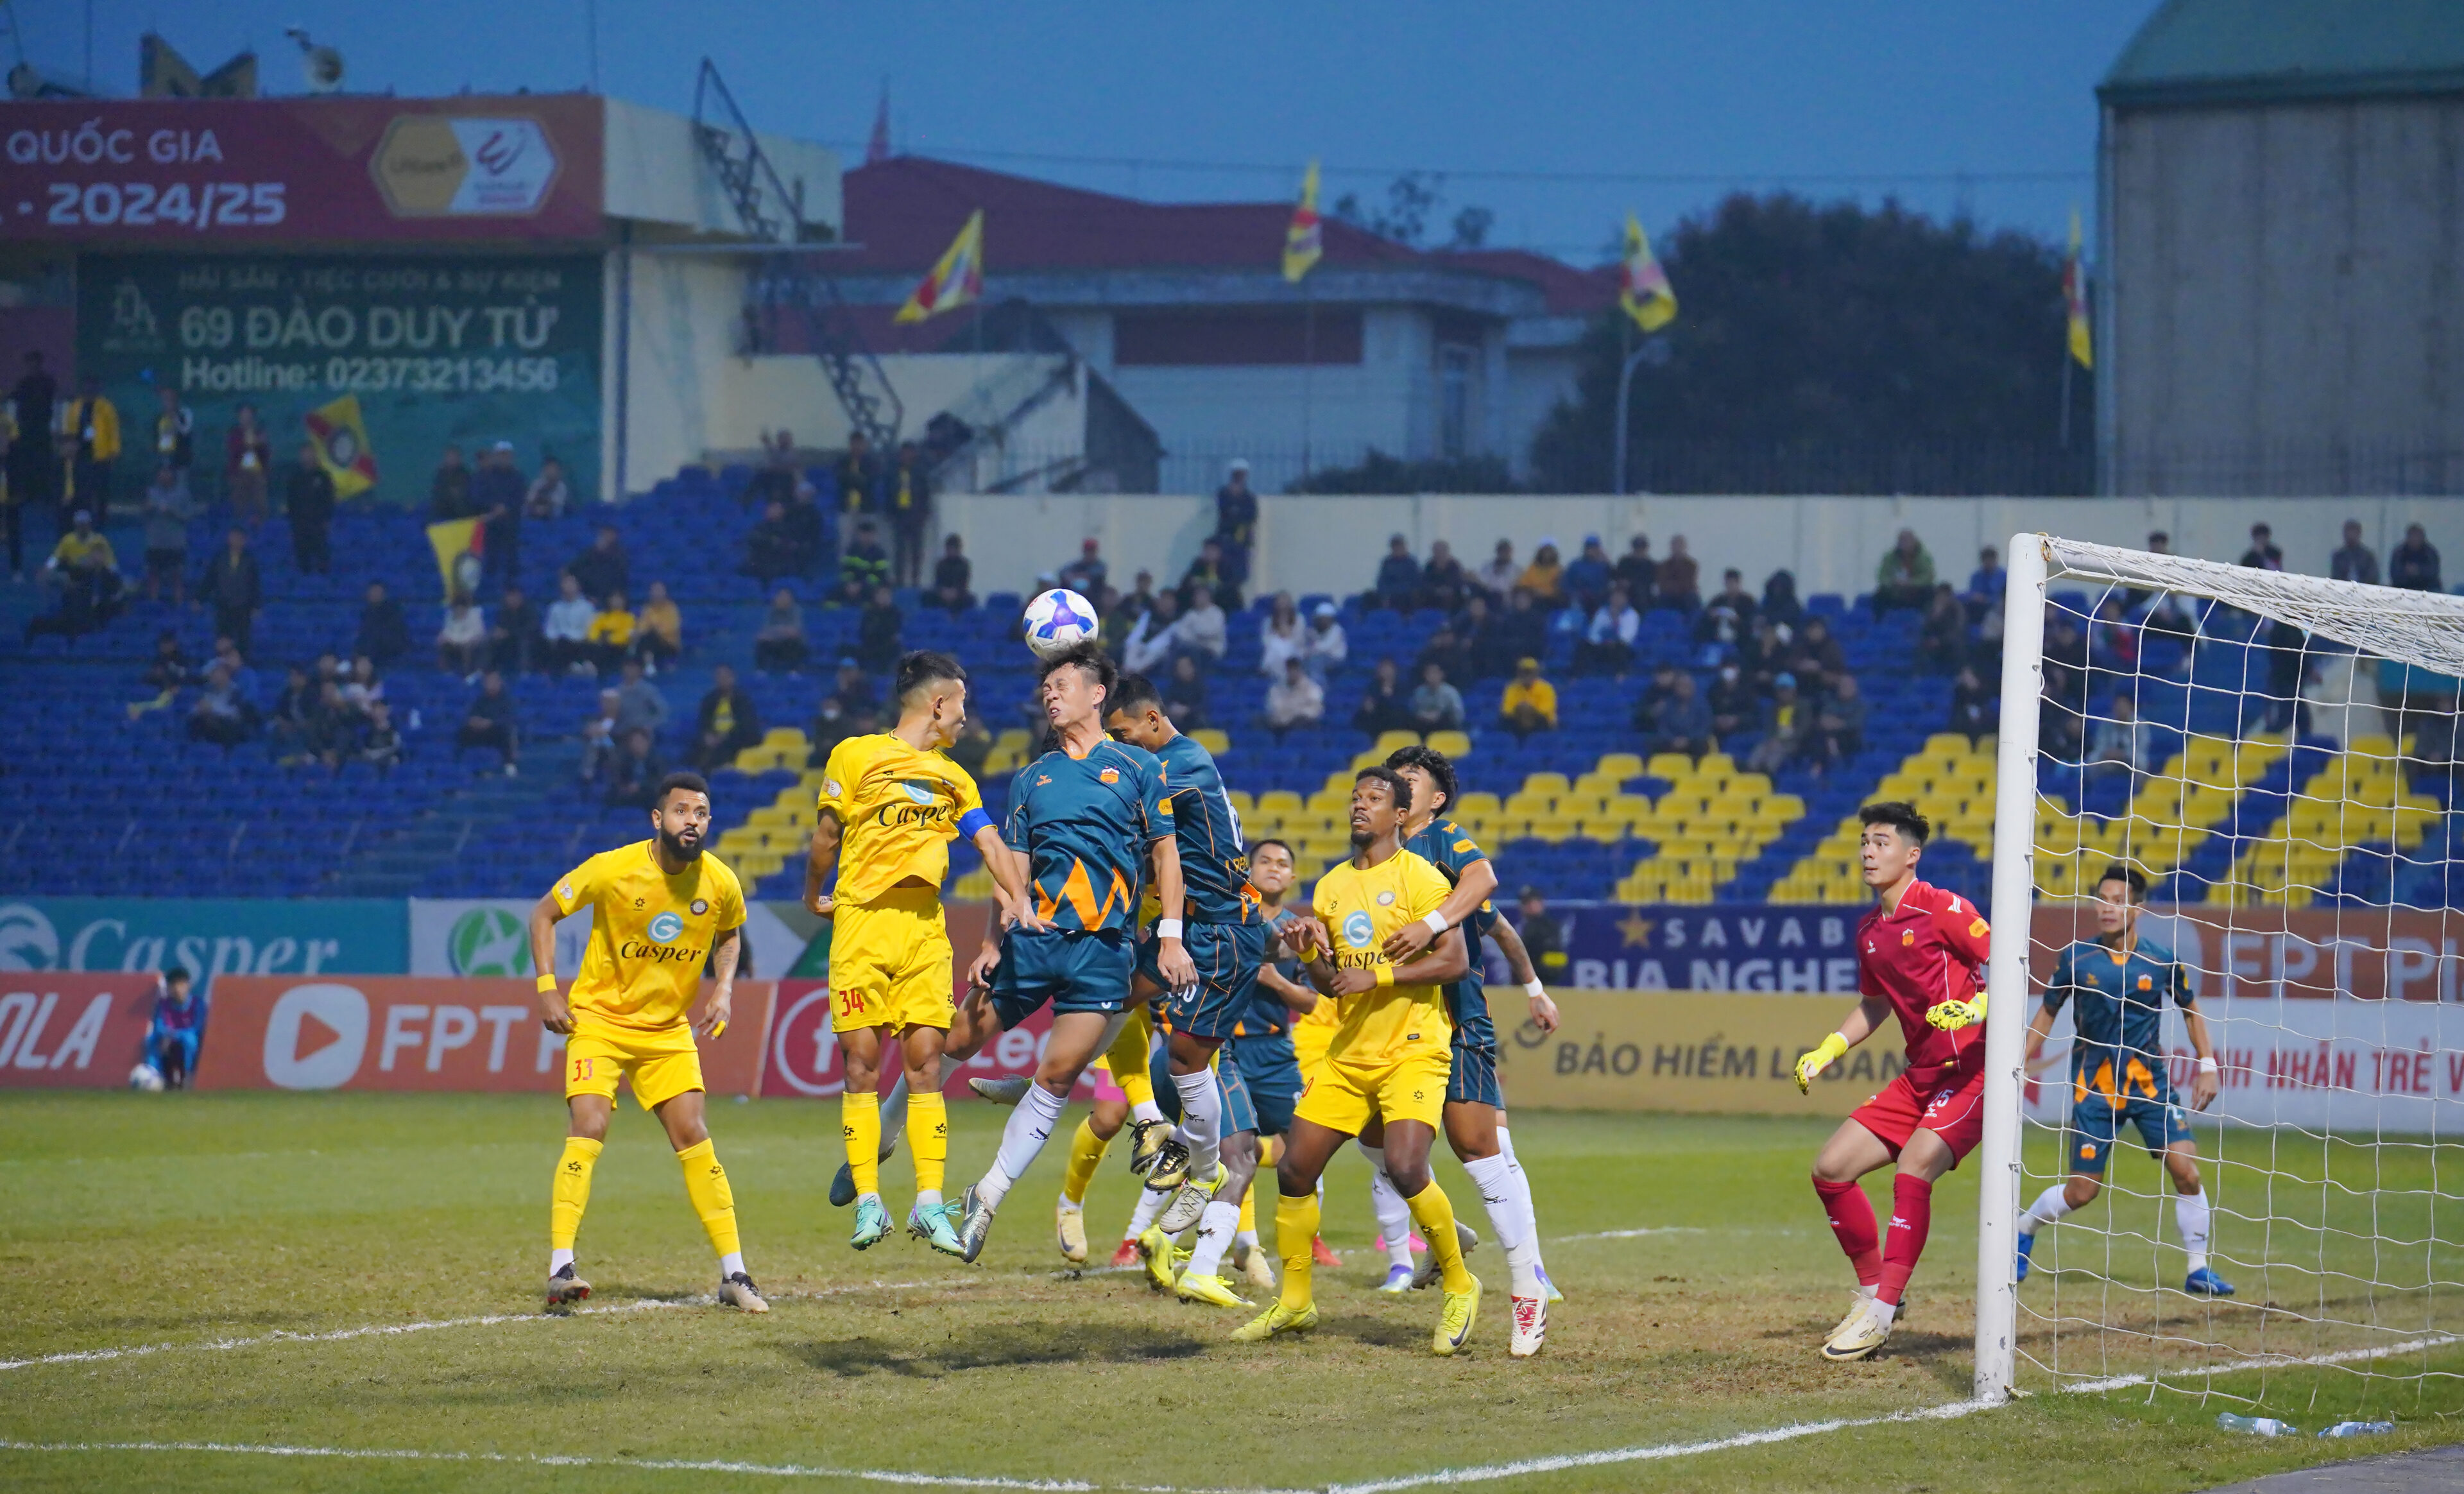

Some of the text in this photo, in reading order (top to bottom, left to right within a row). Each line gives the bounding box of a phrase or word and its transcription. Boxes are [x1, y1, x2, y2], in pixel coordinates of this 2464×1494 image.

[6, 116, 223, 164] QUỐC GIA
[47, 182, 287, 232] 2024/25
[180, 305, 234, 348] 69
[244, 293, 355, 348] ĐÀO
[366, 305, 472, 348] DUY
[182, 355, 559, 392] Hotline: 02373213456
[878, 804, 950, 827] Caspe
[621, 941, 701, 963] Casper
[2221, 934, 2371, 1001] FPT
[1573, 959, 1670, 989] BIA
[839, 988, 865, 1017] 34
[379, 1004, 529, 1074] FPT
[1555, 1032, 1641, 1076] BẢO
[573, 1058, 593, 1082] 33
